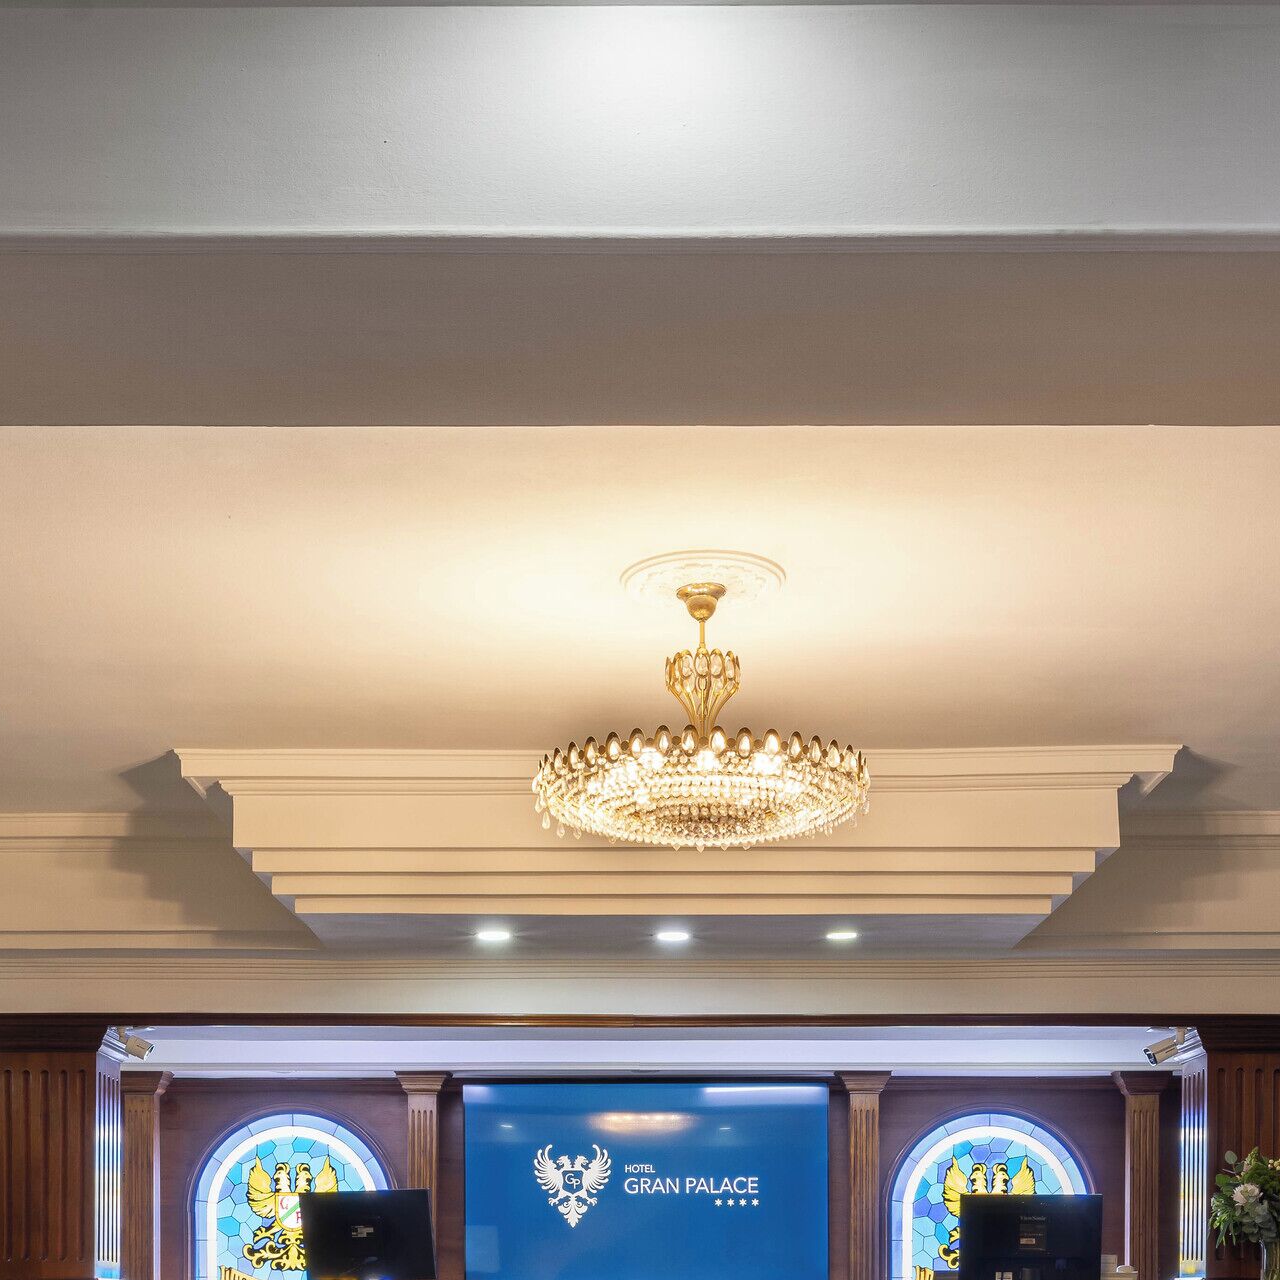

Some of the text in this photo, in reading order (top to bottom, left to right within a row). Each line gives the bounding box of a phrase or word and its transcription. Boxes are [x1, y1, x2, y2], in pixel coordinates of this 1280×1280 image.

[624, 1164, 655, 1173] HOTEL
[624, 1177, 759, 1194] GRAN PALACE
